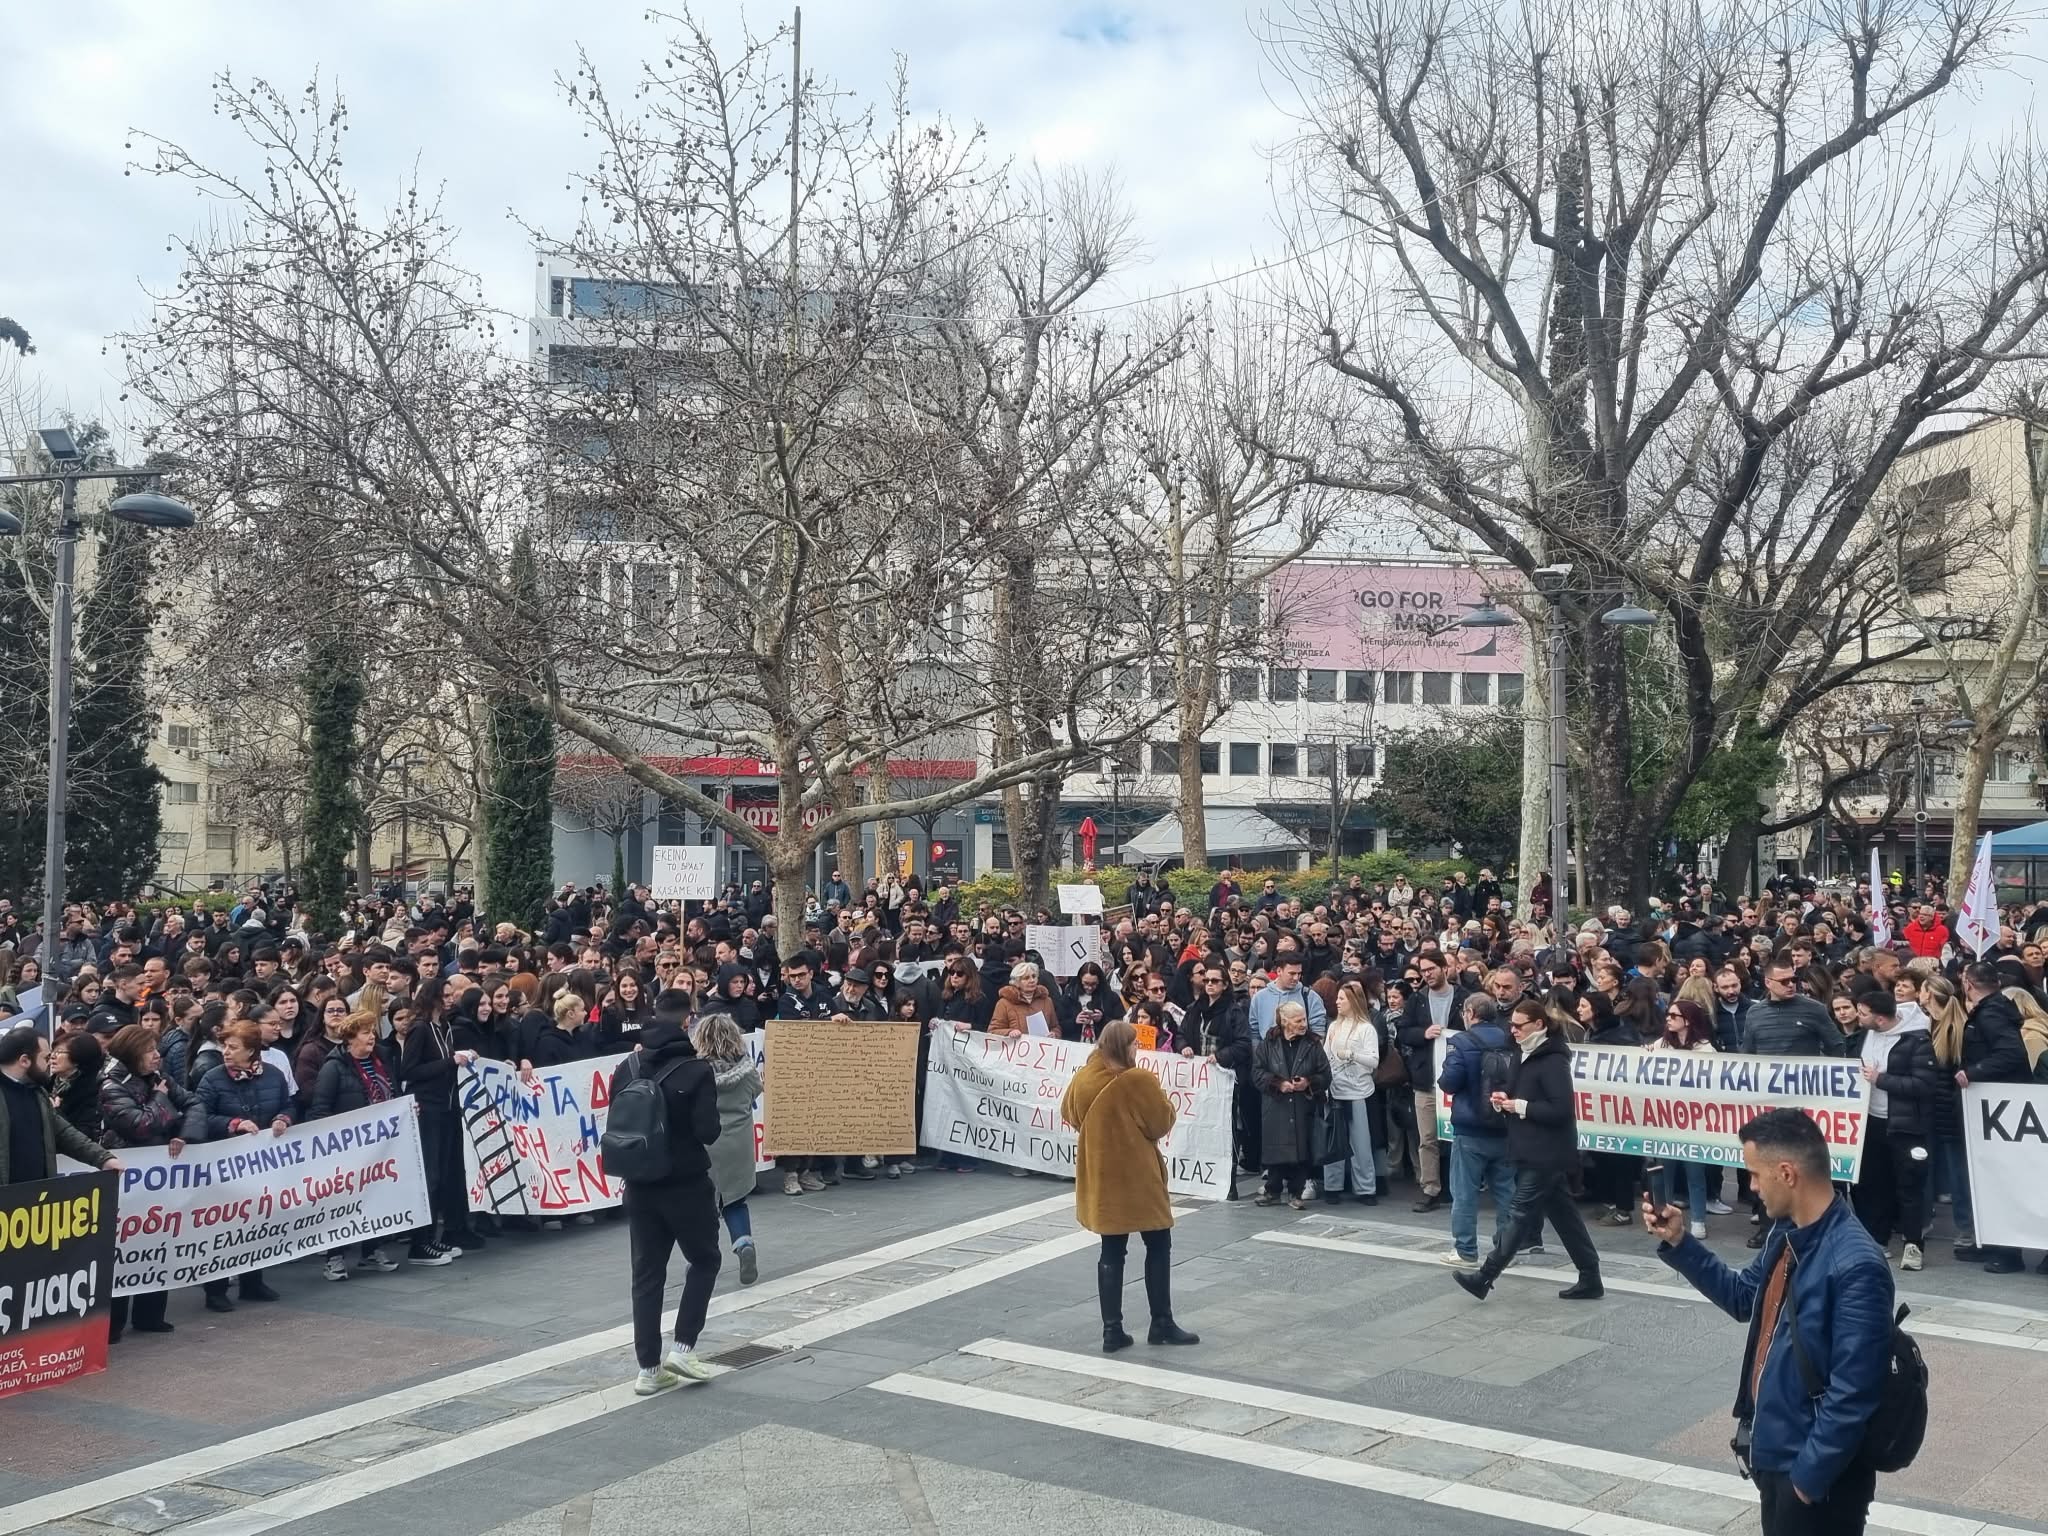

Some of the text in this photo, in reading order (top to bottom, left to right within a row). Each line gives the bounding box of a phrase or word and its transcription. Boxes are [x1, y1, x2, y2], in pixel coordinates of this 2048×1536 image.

[1360, 590, 1443, 609] GO FOR
[1285, 641, 1312, 649] ΘΝΙΚΗ
[655, 849, 687, 862] ΕΚΕΙΝΟ
[668, 863, 677, 871] ΤΟ
[656, 886, 713, 897] ΧΑΣΑΜΕ ΚΑΤΙ
[675, 873, 698, 883] ΟΛΟΙ
[952, 1030, 970, 1054] Η
[953, 1066, 994, 1088] παιδιών
[1002, 1080, 1028, 1096] μας
[1038, 1077, 1063, 1098] δεν
[1594, 1052, 1628, 1083] ΓΙΑ
[1636, 1055, 1714, 1090] ΚΕΡΔΗ
[1720, 1060, 1761, 1093] ΚΑΙ
[1768, 1062, 1862, 1099] ΖΗΜΙΕΣ
[544, 1076, 580, 1116] ΤΑ
[1600, 1094, 1636, 1126] ΓΙΑ
[1642, 1097, 1777, 1135] ΑΝΘΡΩΠΙ
[1804, 1108, 1861, 1146] ΩΕΣ
[1980, 1099, 2048, 1144] ΚΑ
[124, 1116, 400, 1193] ΡΟΠΗ ΕΙΡΗΝΗΣ ΛΑΡΙΣΑΣ
[1030, 1136, 1079, 1165] ΓΟΝΕ
[1596, 1136, 1628, 1151] ΕΣΥ
[540, 1154, 610, 1209] ΔΕΝ
[116, 1158, 398, 1244] ρδη τους ή οι ζωές μας
[114, 1200, 362, 1265] λοκή της Ελλάδας από τους
[114, 1210, 414, 1289] κούς σχεδιασμούς και πολέμους
[22, 1260, 97, 1330] μας!
[24, 1366, 66, 1384] Τεμπών
